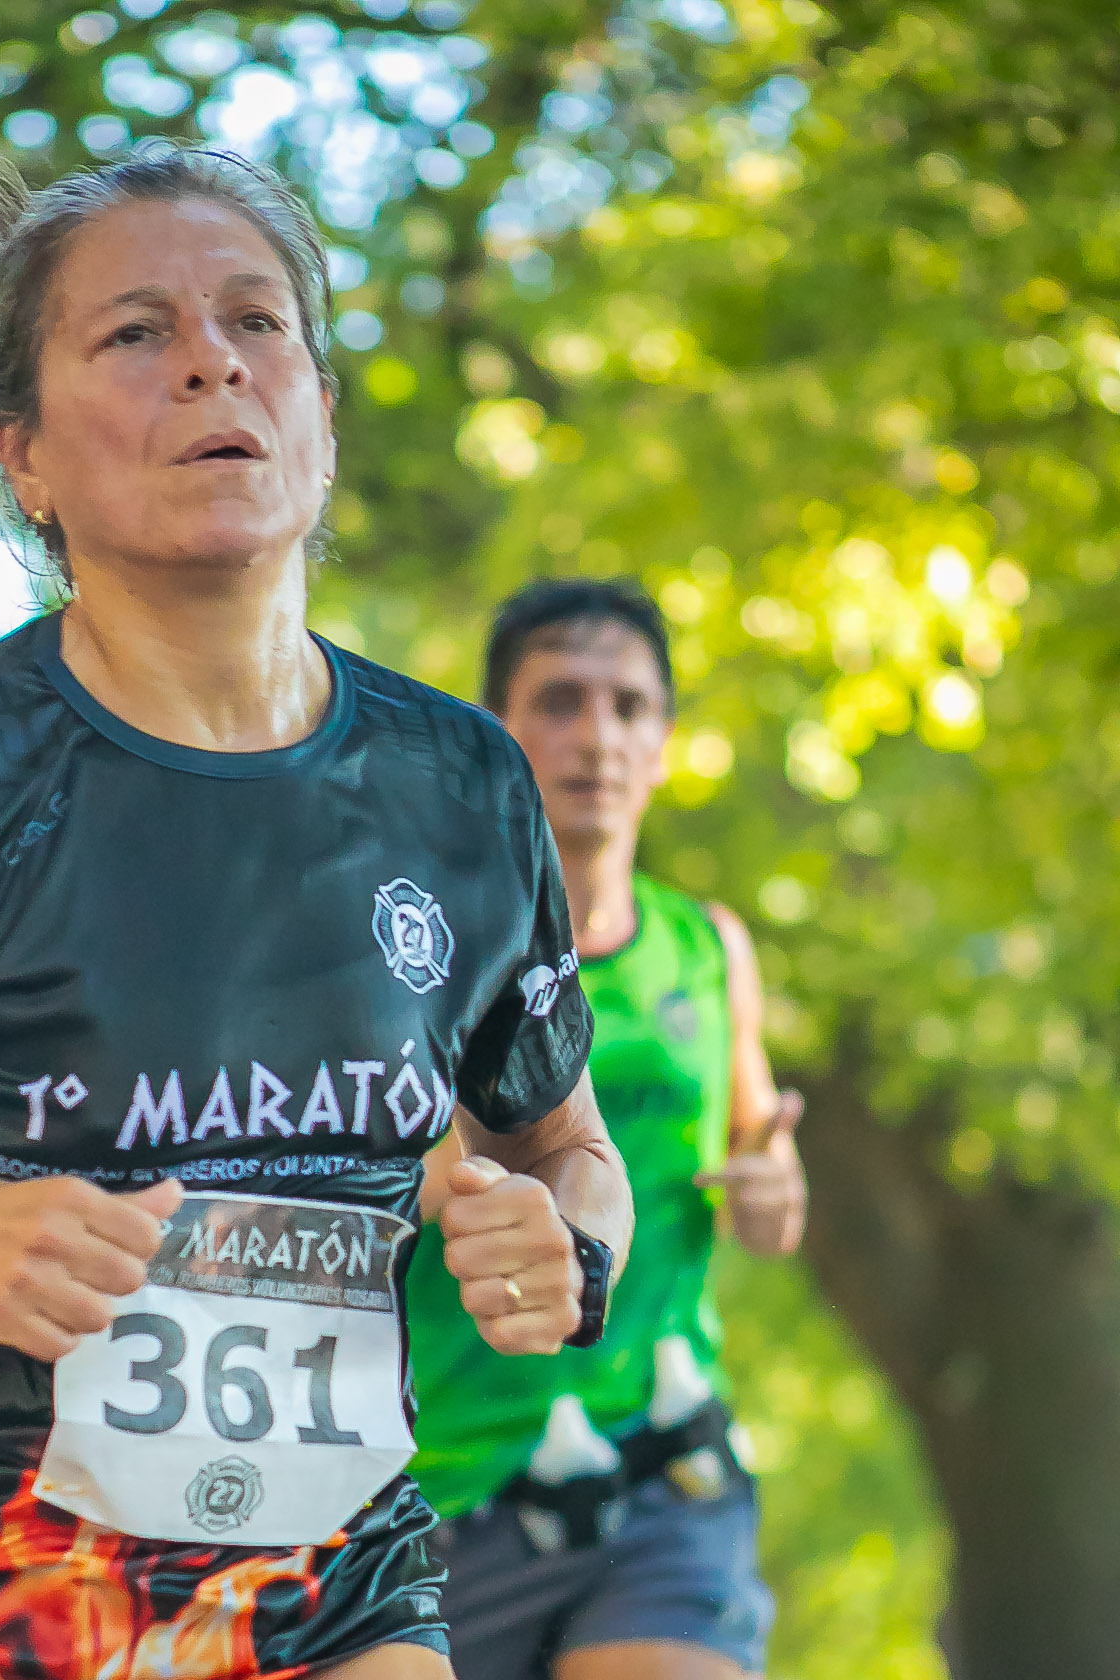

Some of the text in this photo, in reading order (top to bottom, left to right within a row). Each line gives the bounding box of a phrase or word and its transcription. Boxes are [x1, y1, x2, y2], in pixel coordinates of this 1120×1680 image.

[114, 1038, 457, 1152] MARATÓN
[157, 1156, 263, 1184] BEROS
[178, 1218, 373, 1278] MARATÓN
[101, 1311, 366, 1449] 361
[207, 1478, 242, 1507] 27
